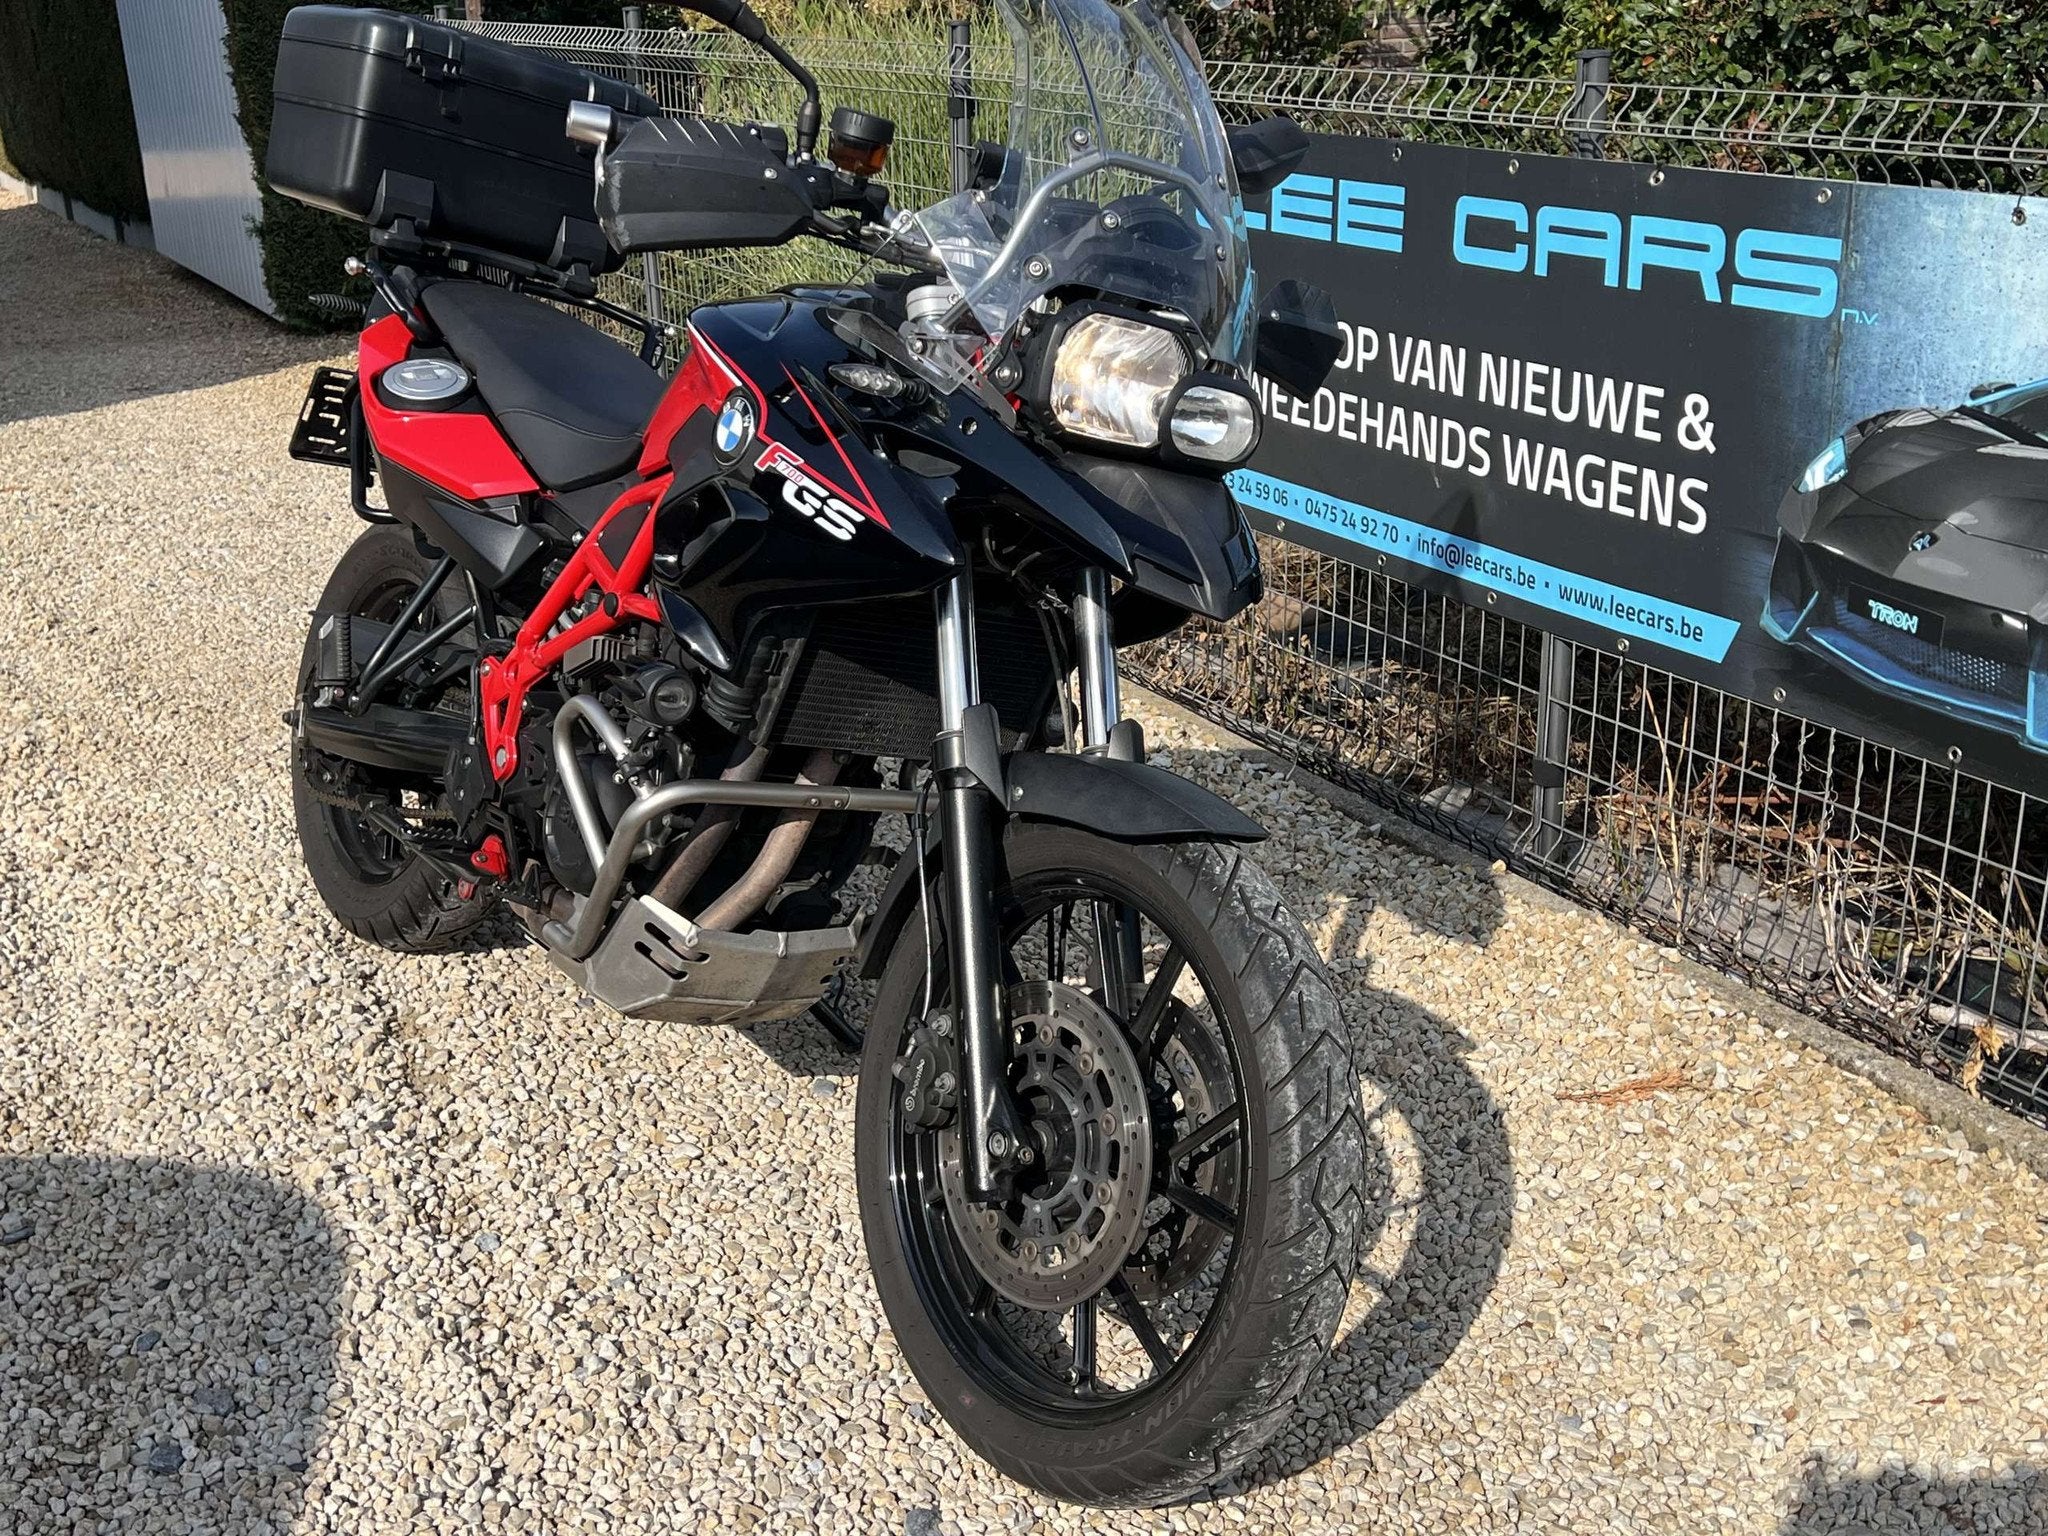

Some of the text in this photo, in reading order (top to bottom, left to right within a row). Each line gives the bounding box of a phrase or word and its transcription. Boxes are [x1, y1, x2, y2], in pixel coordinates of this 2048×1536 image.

[1453, 195, 1843, 318] CARS
[1388, 332, 1466, 398] VAN
[1478, 352, 1665, 443] NIEUWE
[1677, 393, 1717, 455] &
[782, 479, 866, 541] GS
[1502, 433, 1709, 535] WAGENS
[1238, 476, 1252, 495] 24
[1255, 482, 1270, 500] 59
[1273, 487, 1288, 507] 06
[1305, 498, 1338, 523] 0475
[1341, 510, 1357, 531] 24
[1361, 516, 1378, 537] 92
[1382, 523, 1399, 544] 70
[1417, 533, 1536, 590] info@leecars.be
[1559, 583, 1704, 642] www.leecars.be
[1868, 599, 1919, 634] TRON
